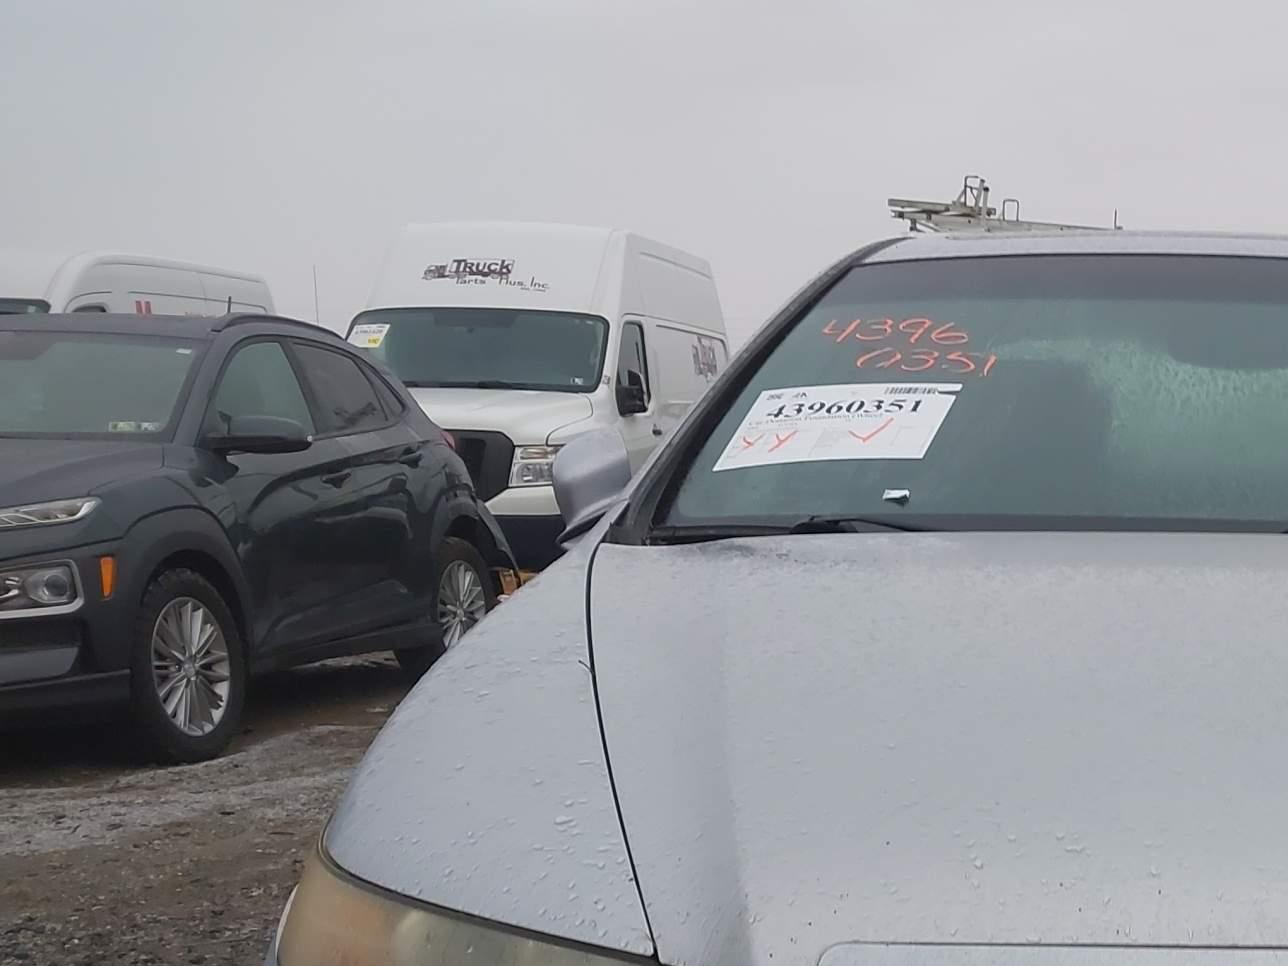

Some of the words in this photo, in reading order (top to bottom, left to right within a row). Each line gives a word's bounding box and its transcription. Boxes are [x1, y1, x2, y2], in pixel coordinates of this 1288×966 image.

[822, 318, 969, 345] 4396
[856, 347, 997, 377] 0351
[766, 399, 923, 419] 43960351
